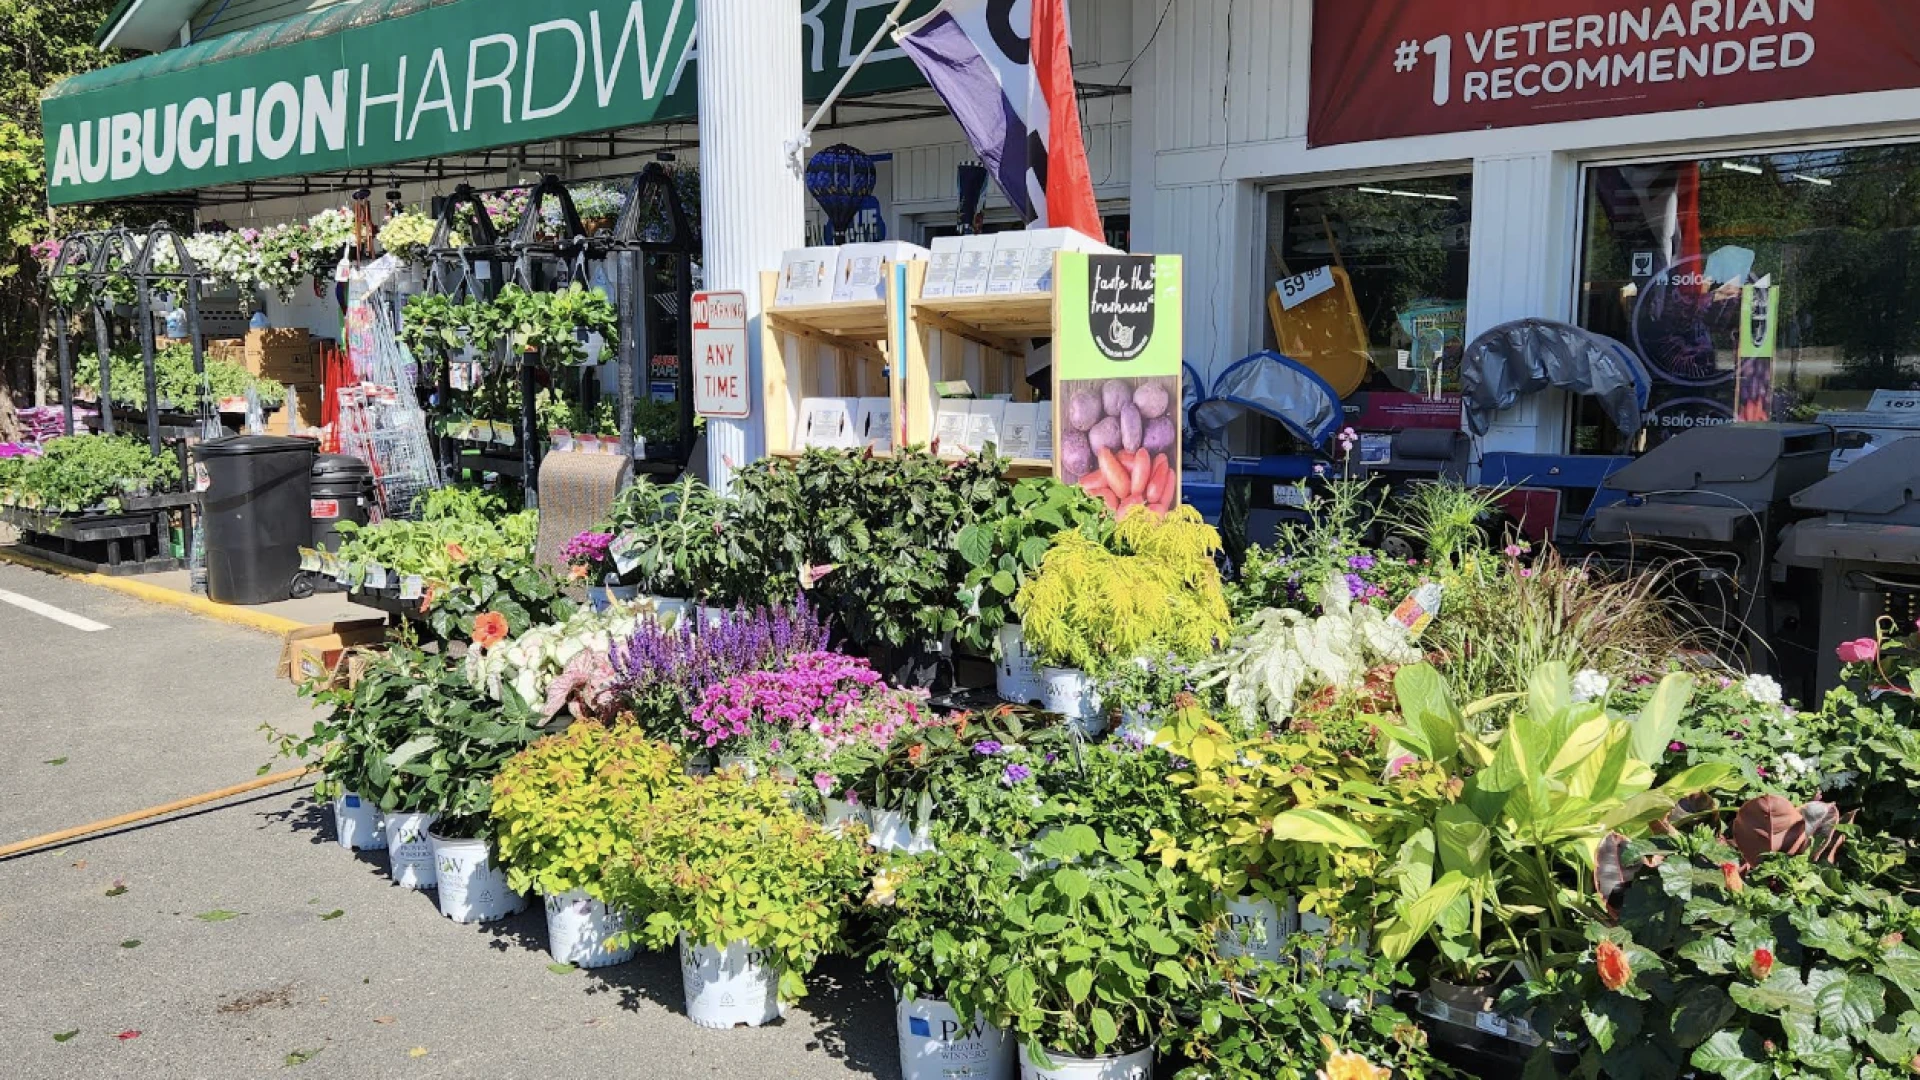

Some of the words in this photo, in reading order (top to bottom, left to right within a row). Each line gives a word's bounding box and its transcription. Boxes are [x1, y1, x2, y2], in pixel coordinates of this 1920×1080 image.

[1465, 0, 1815, 63] VETERINARIAN
[1463, 31, 1816, 104] RECOMMENDED
[52, 69, 348, 187] AUBUCHON
[1131, 265, 1153, 290] the
[694, 301, 708, 323] NO
[709, 302, 743, 320] PARKING
[706, 344, 734, 366] ANY
[704, 376, 738, 398] TIME
[1662, 413, 1694, 427] solo
[941, 1019, 986, 1041] PW
[941, 1050, 987, 1060] WINNERS
[943, 1042, 984, 1052] PROVEN
